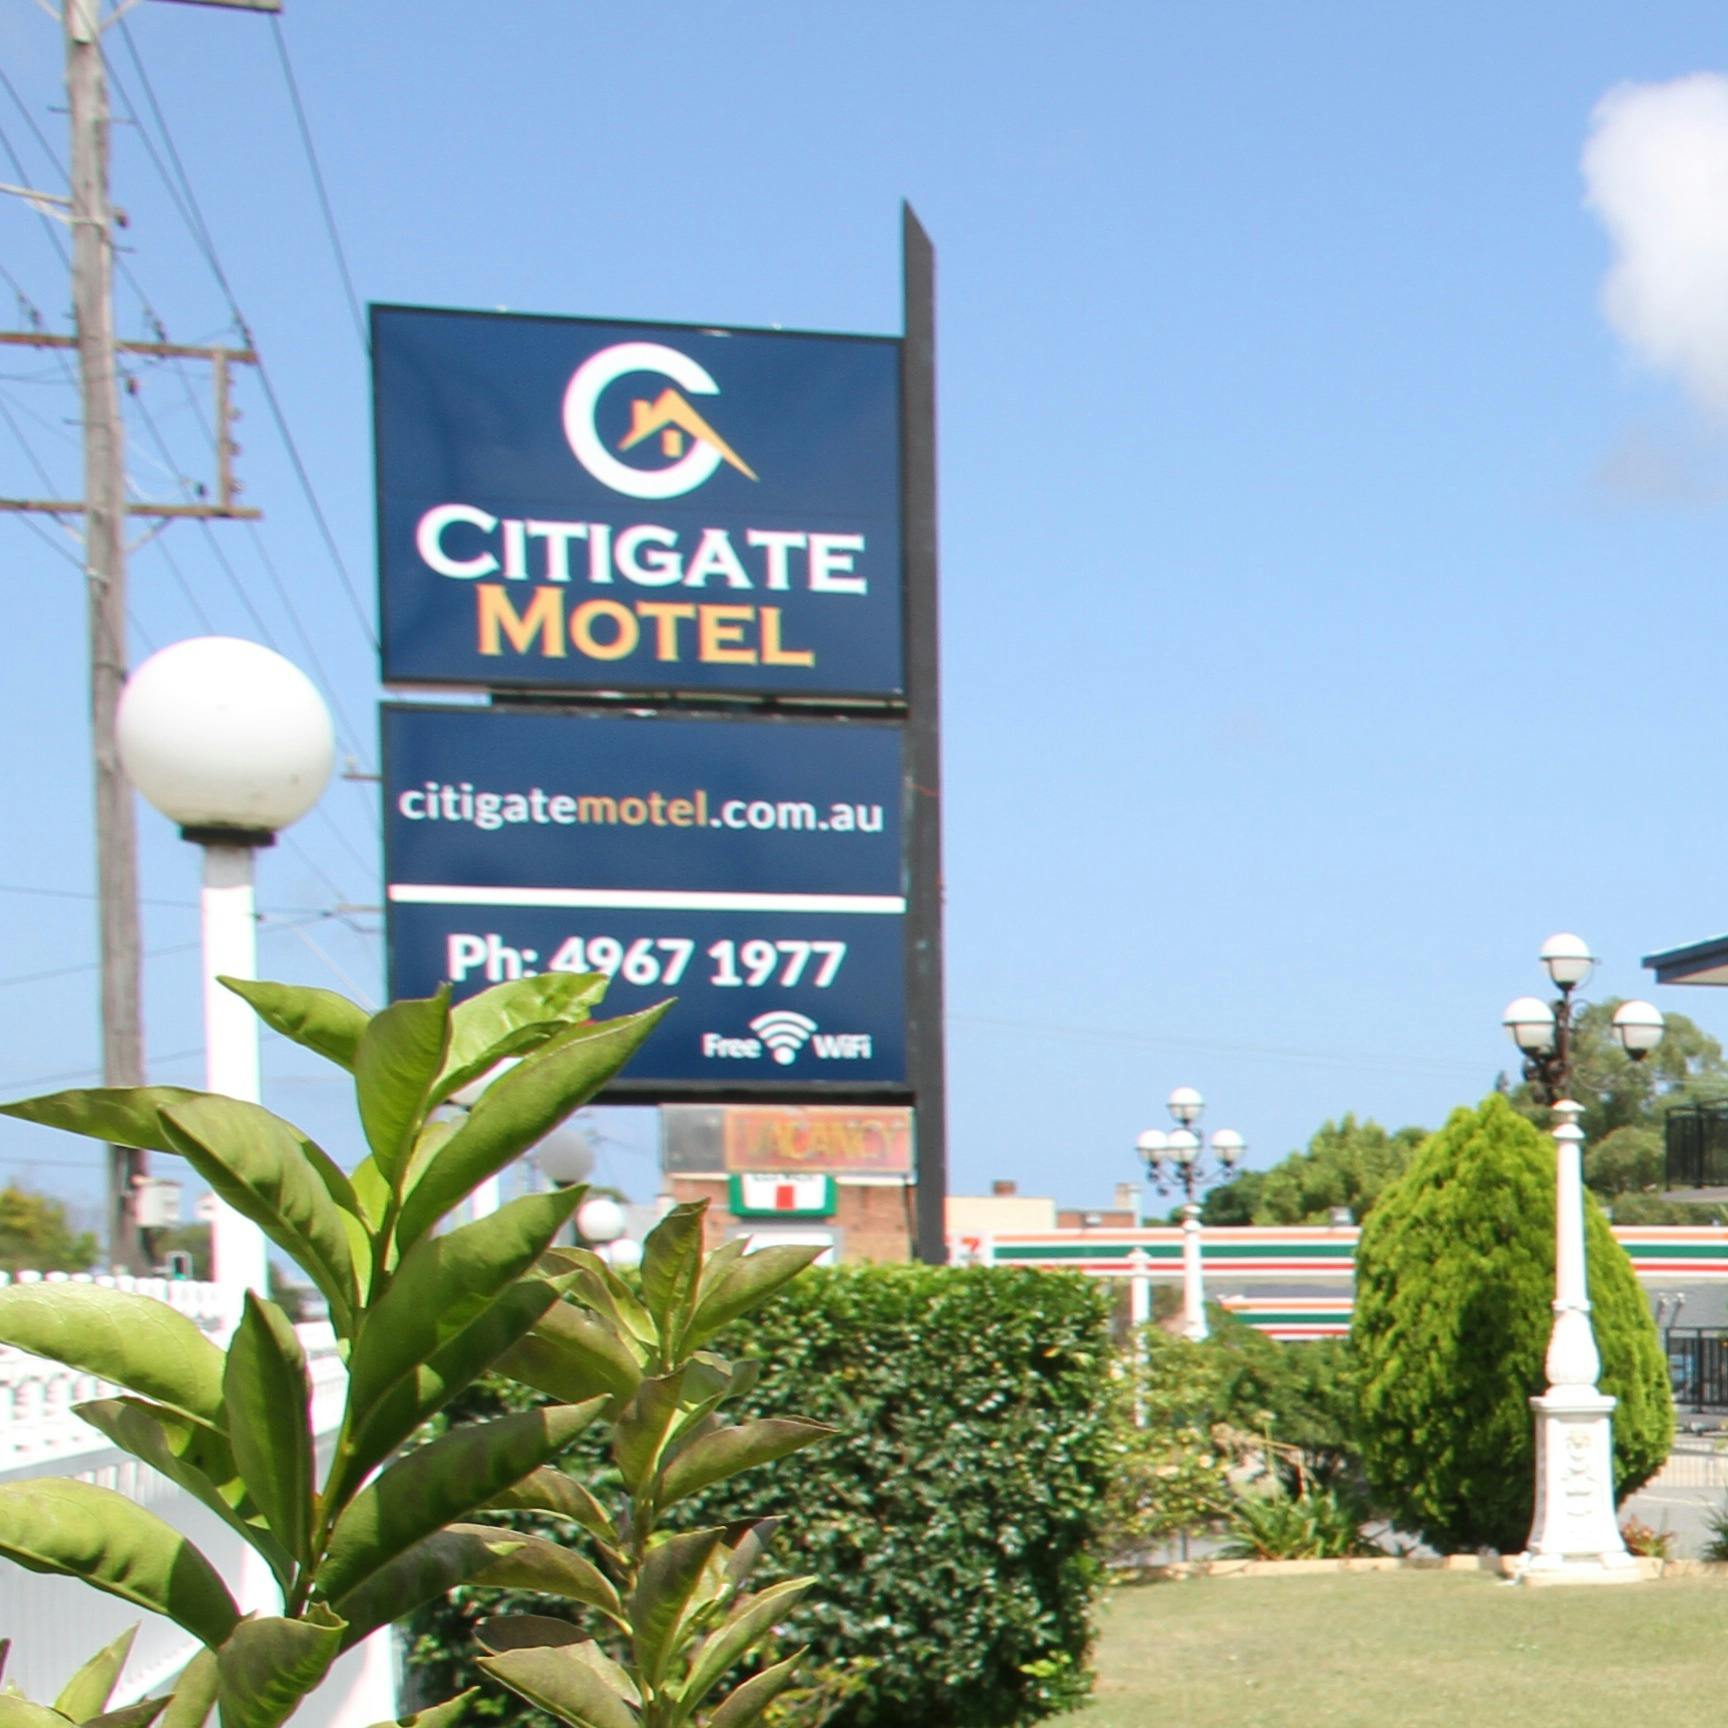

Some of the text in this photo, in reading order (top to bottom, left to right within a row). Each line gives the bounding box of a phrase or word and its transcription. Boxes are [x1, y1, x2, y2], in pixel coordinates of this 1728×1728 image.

[416, 503, 868, 595] CITIGATE
[476, 583, 816, 668] MOTEL
[399, 782, 884, 833] citigatemotel.com.au
[447, 934, 847, 988] Ph: 4967 1977
[703, 1034, 762, 1060] Free
